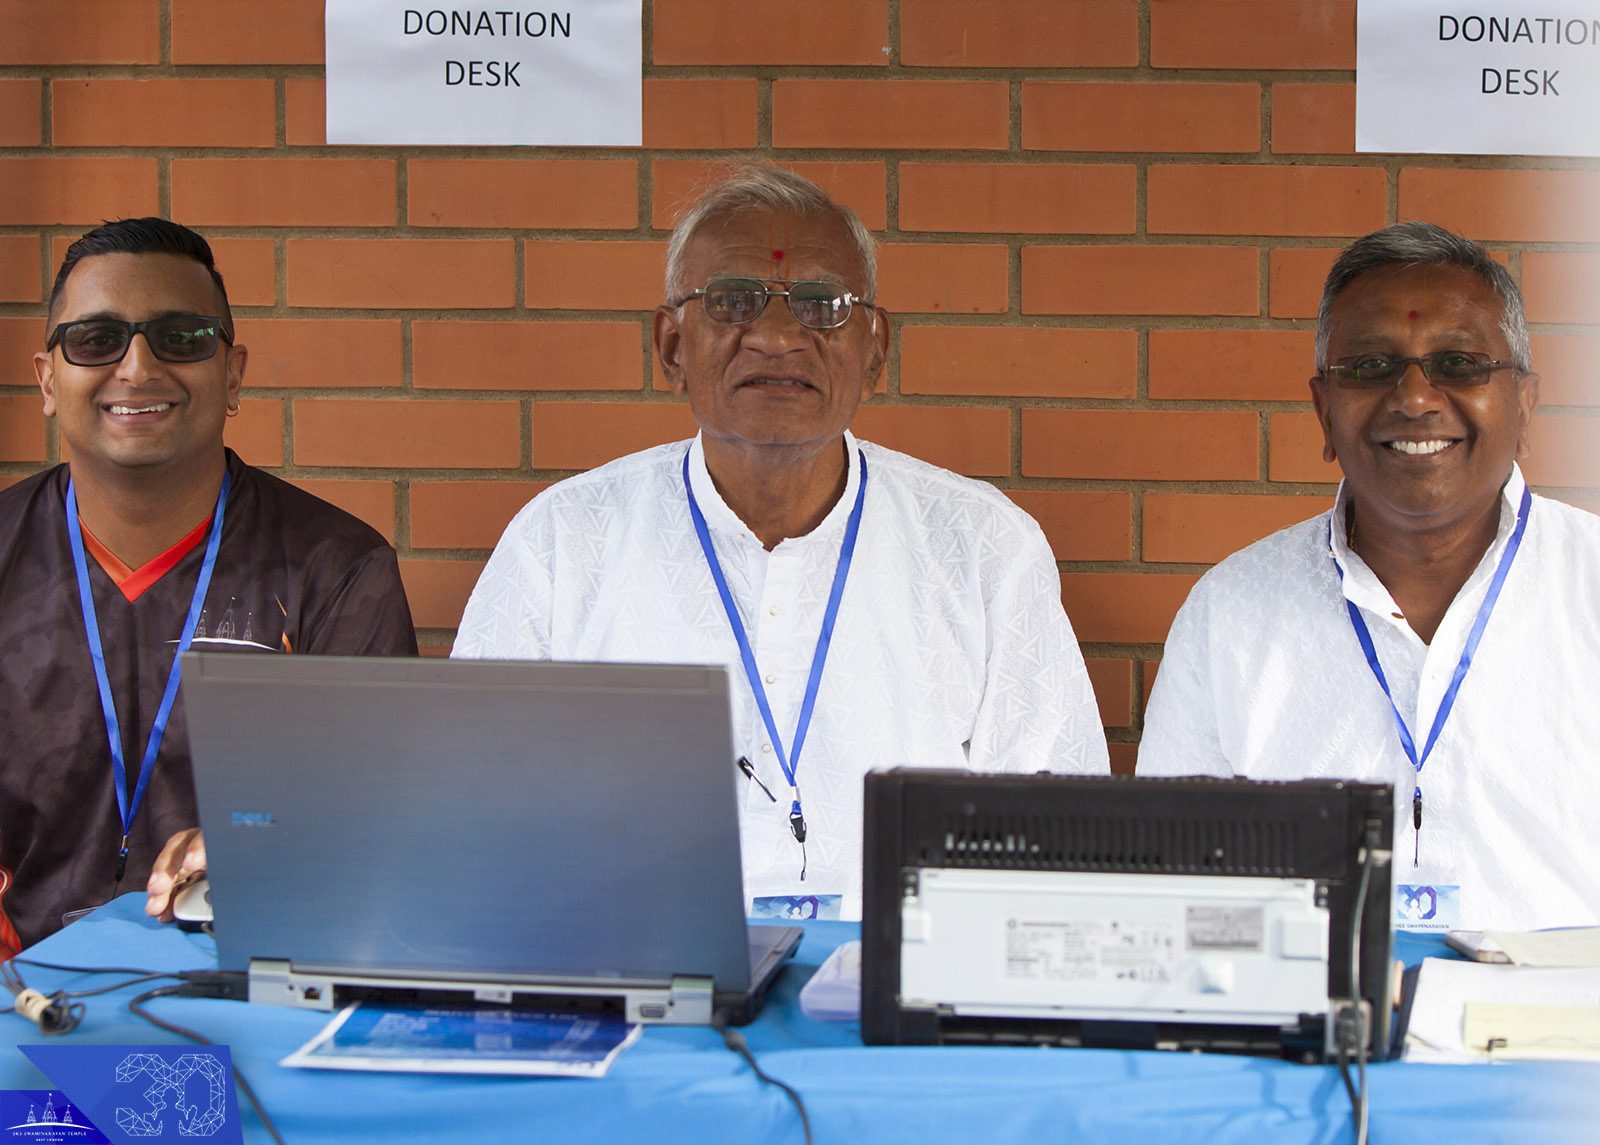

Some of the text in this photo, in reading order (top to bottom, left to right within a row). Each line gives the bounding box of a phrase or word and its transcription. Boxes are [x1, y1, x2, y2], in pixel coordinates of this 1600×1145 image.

[403, 9, 571, 38] DONATION
[445, 60, 522, 87] DESK
[1481, 67, 1560, 96] DESK
